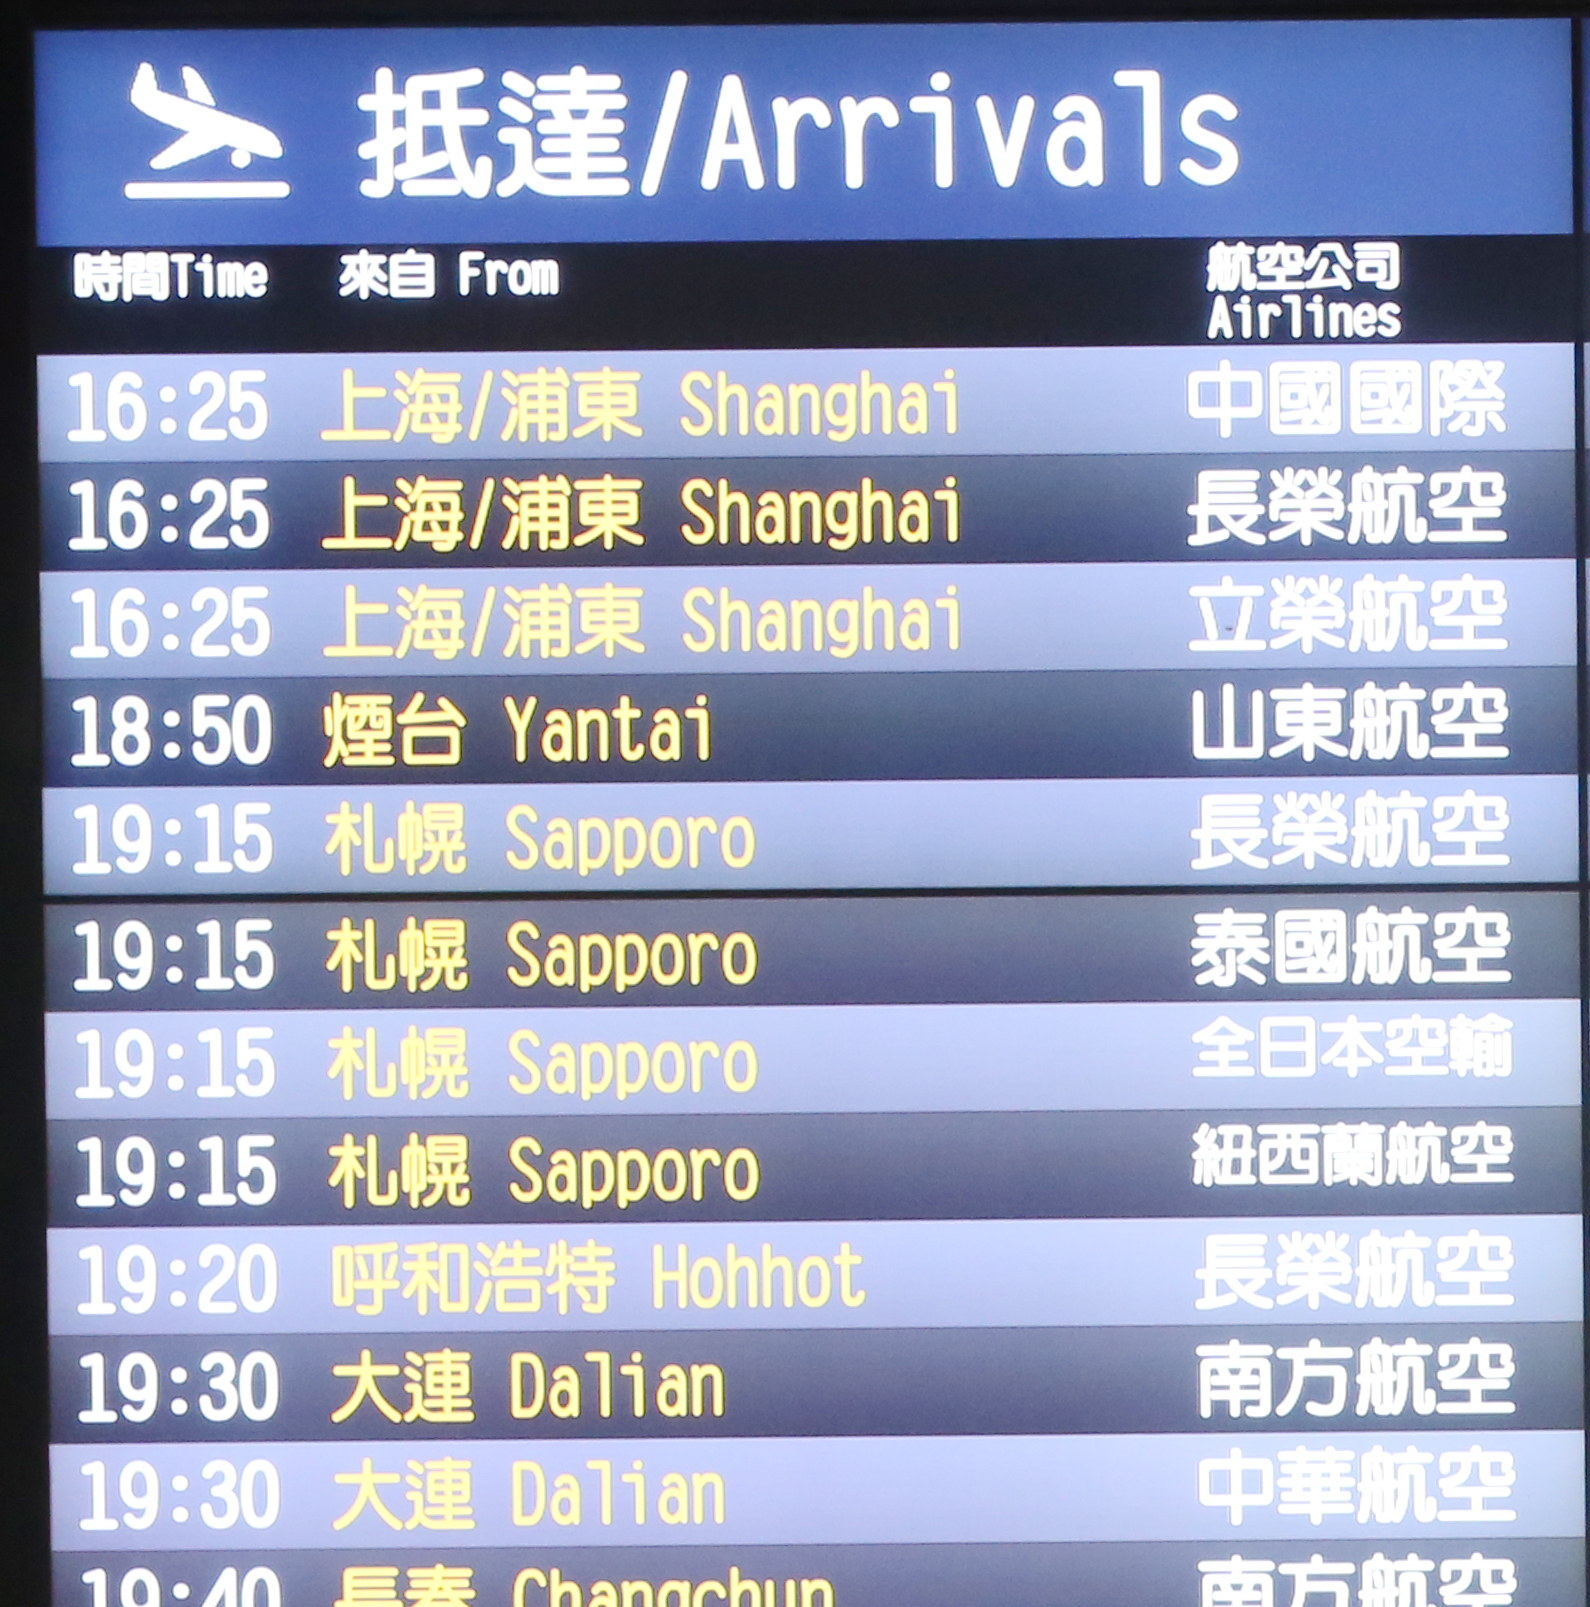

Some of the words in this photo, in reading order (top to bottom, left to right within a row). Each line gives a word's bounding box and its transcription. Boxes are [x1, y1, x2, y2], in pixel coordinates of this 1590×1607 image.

[339, 248, 436, 300] 來自
[458, 250, 560, 296] From
[1206, 240, 1400, 292] 航空公司
[1207, 293, 1402, 339] Airlines
[1186, 357, 1507, 439] 中國國際
[68, 477, 270, 551] 16:25
[321, 472, 645, 552] 上海/浦東
[680, 475, 958, 551] Shanghai
[1186, 464, 1508, 547] 長榮航空
[1187, 571, 1509, 655] 立榮航空
[71, 693, 272, 767] 18:50
[323, 690, 467, 768] 煙台
[503, 694, 709, 763] Yantai
[1191, 680, 1510, 763] 山東航空
[73, 918, 275, 991] 19:15
[325, 915, 469, 993] 札幌
[506, 920, 757, 994] Sapporo
[1190, 904, 1512, 988] 泰國航空
[75, 1134, 277, 1207] 19:15
[327, 1131, 471, 1209] 札幌
[508, 1135, 759, 1210] Sapporo
[1191, 1119, 1515, 1188] 紐西蘭航空
[330, 1237, 617, 1317] 呼和浩特
[651, 1240, 867, 1310] Hohhot
[78, 1350, 279, 1423] 19:30
[330, 1347, 475, 1424] 大連
[510, 1350, 724, 1419] Dalian
[1194, 1335, 1516, 1419] 南方航空
